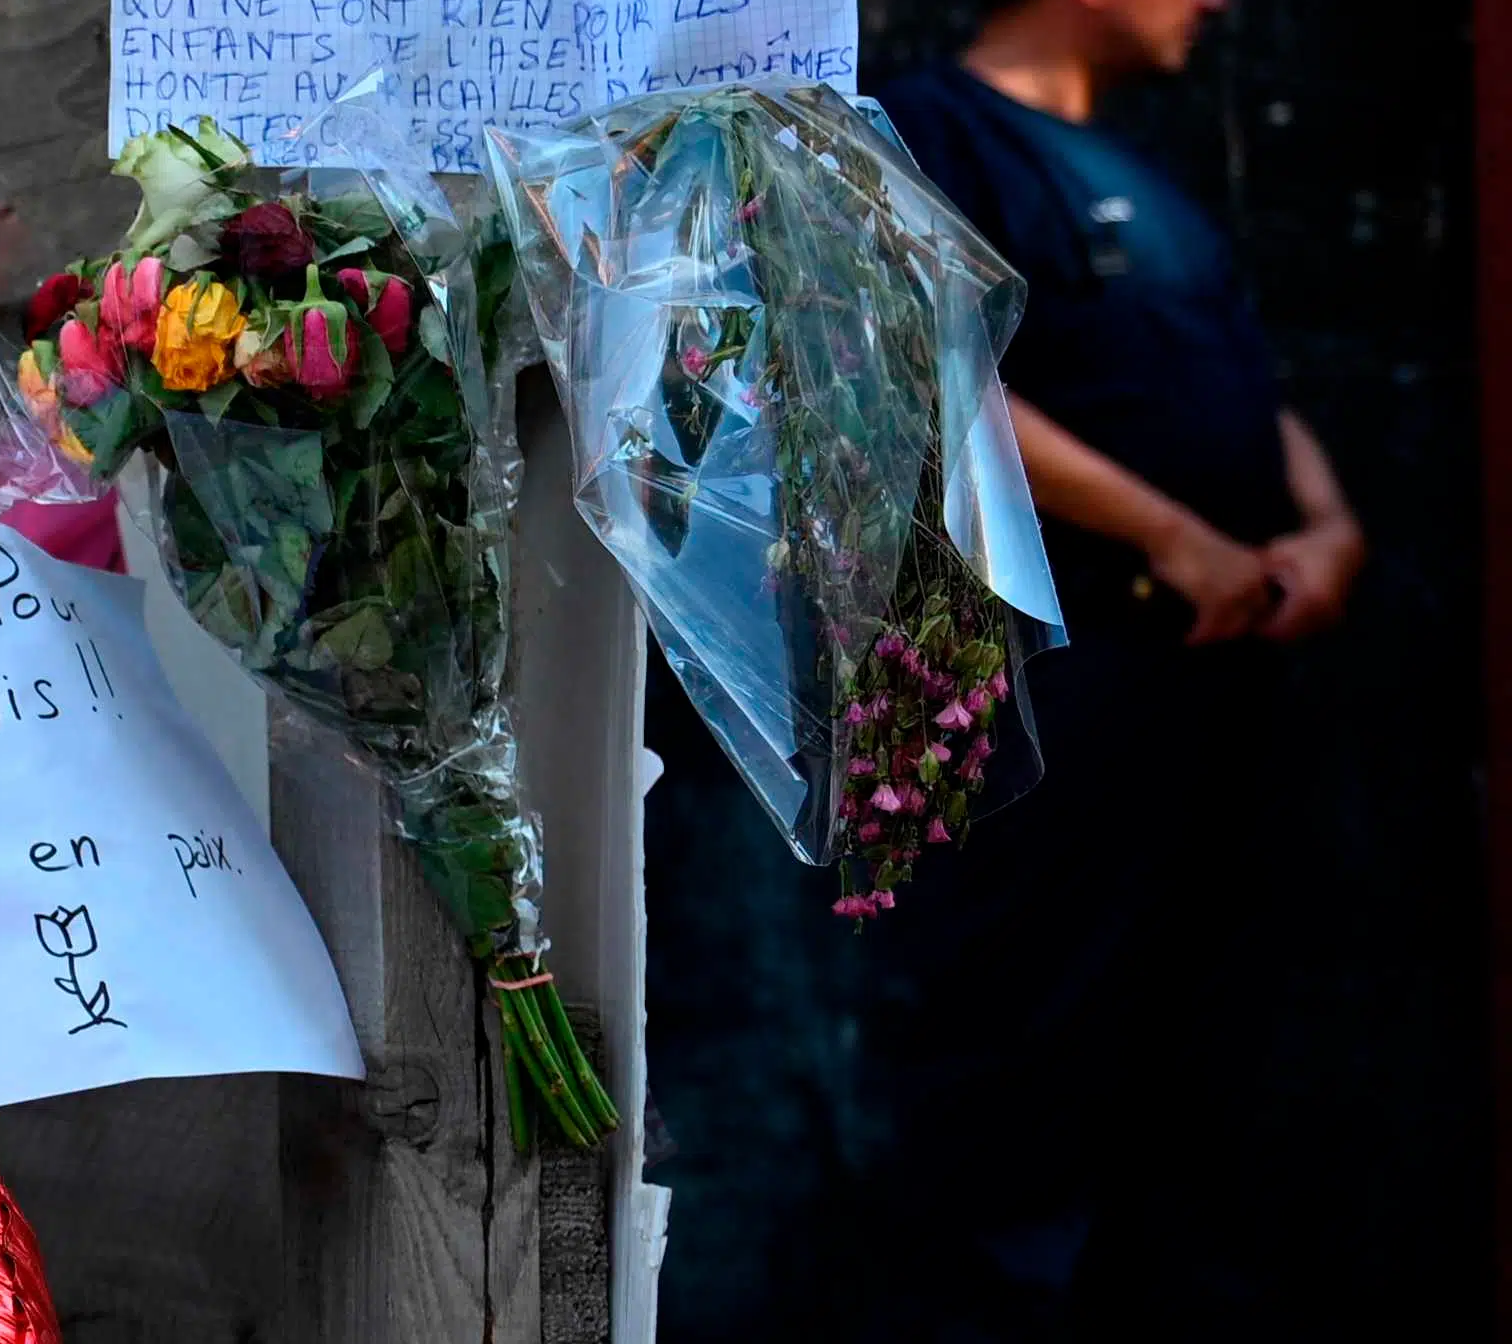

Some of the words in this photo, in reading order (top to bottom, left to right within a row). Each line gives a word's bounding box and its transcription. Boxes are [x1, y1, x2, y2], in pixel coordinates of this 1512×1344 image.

[121, 26, 337, 64] ENFANTS
[125, 64, 268, 104] HONTE
[29, 832, 101, 871] en
